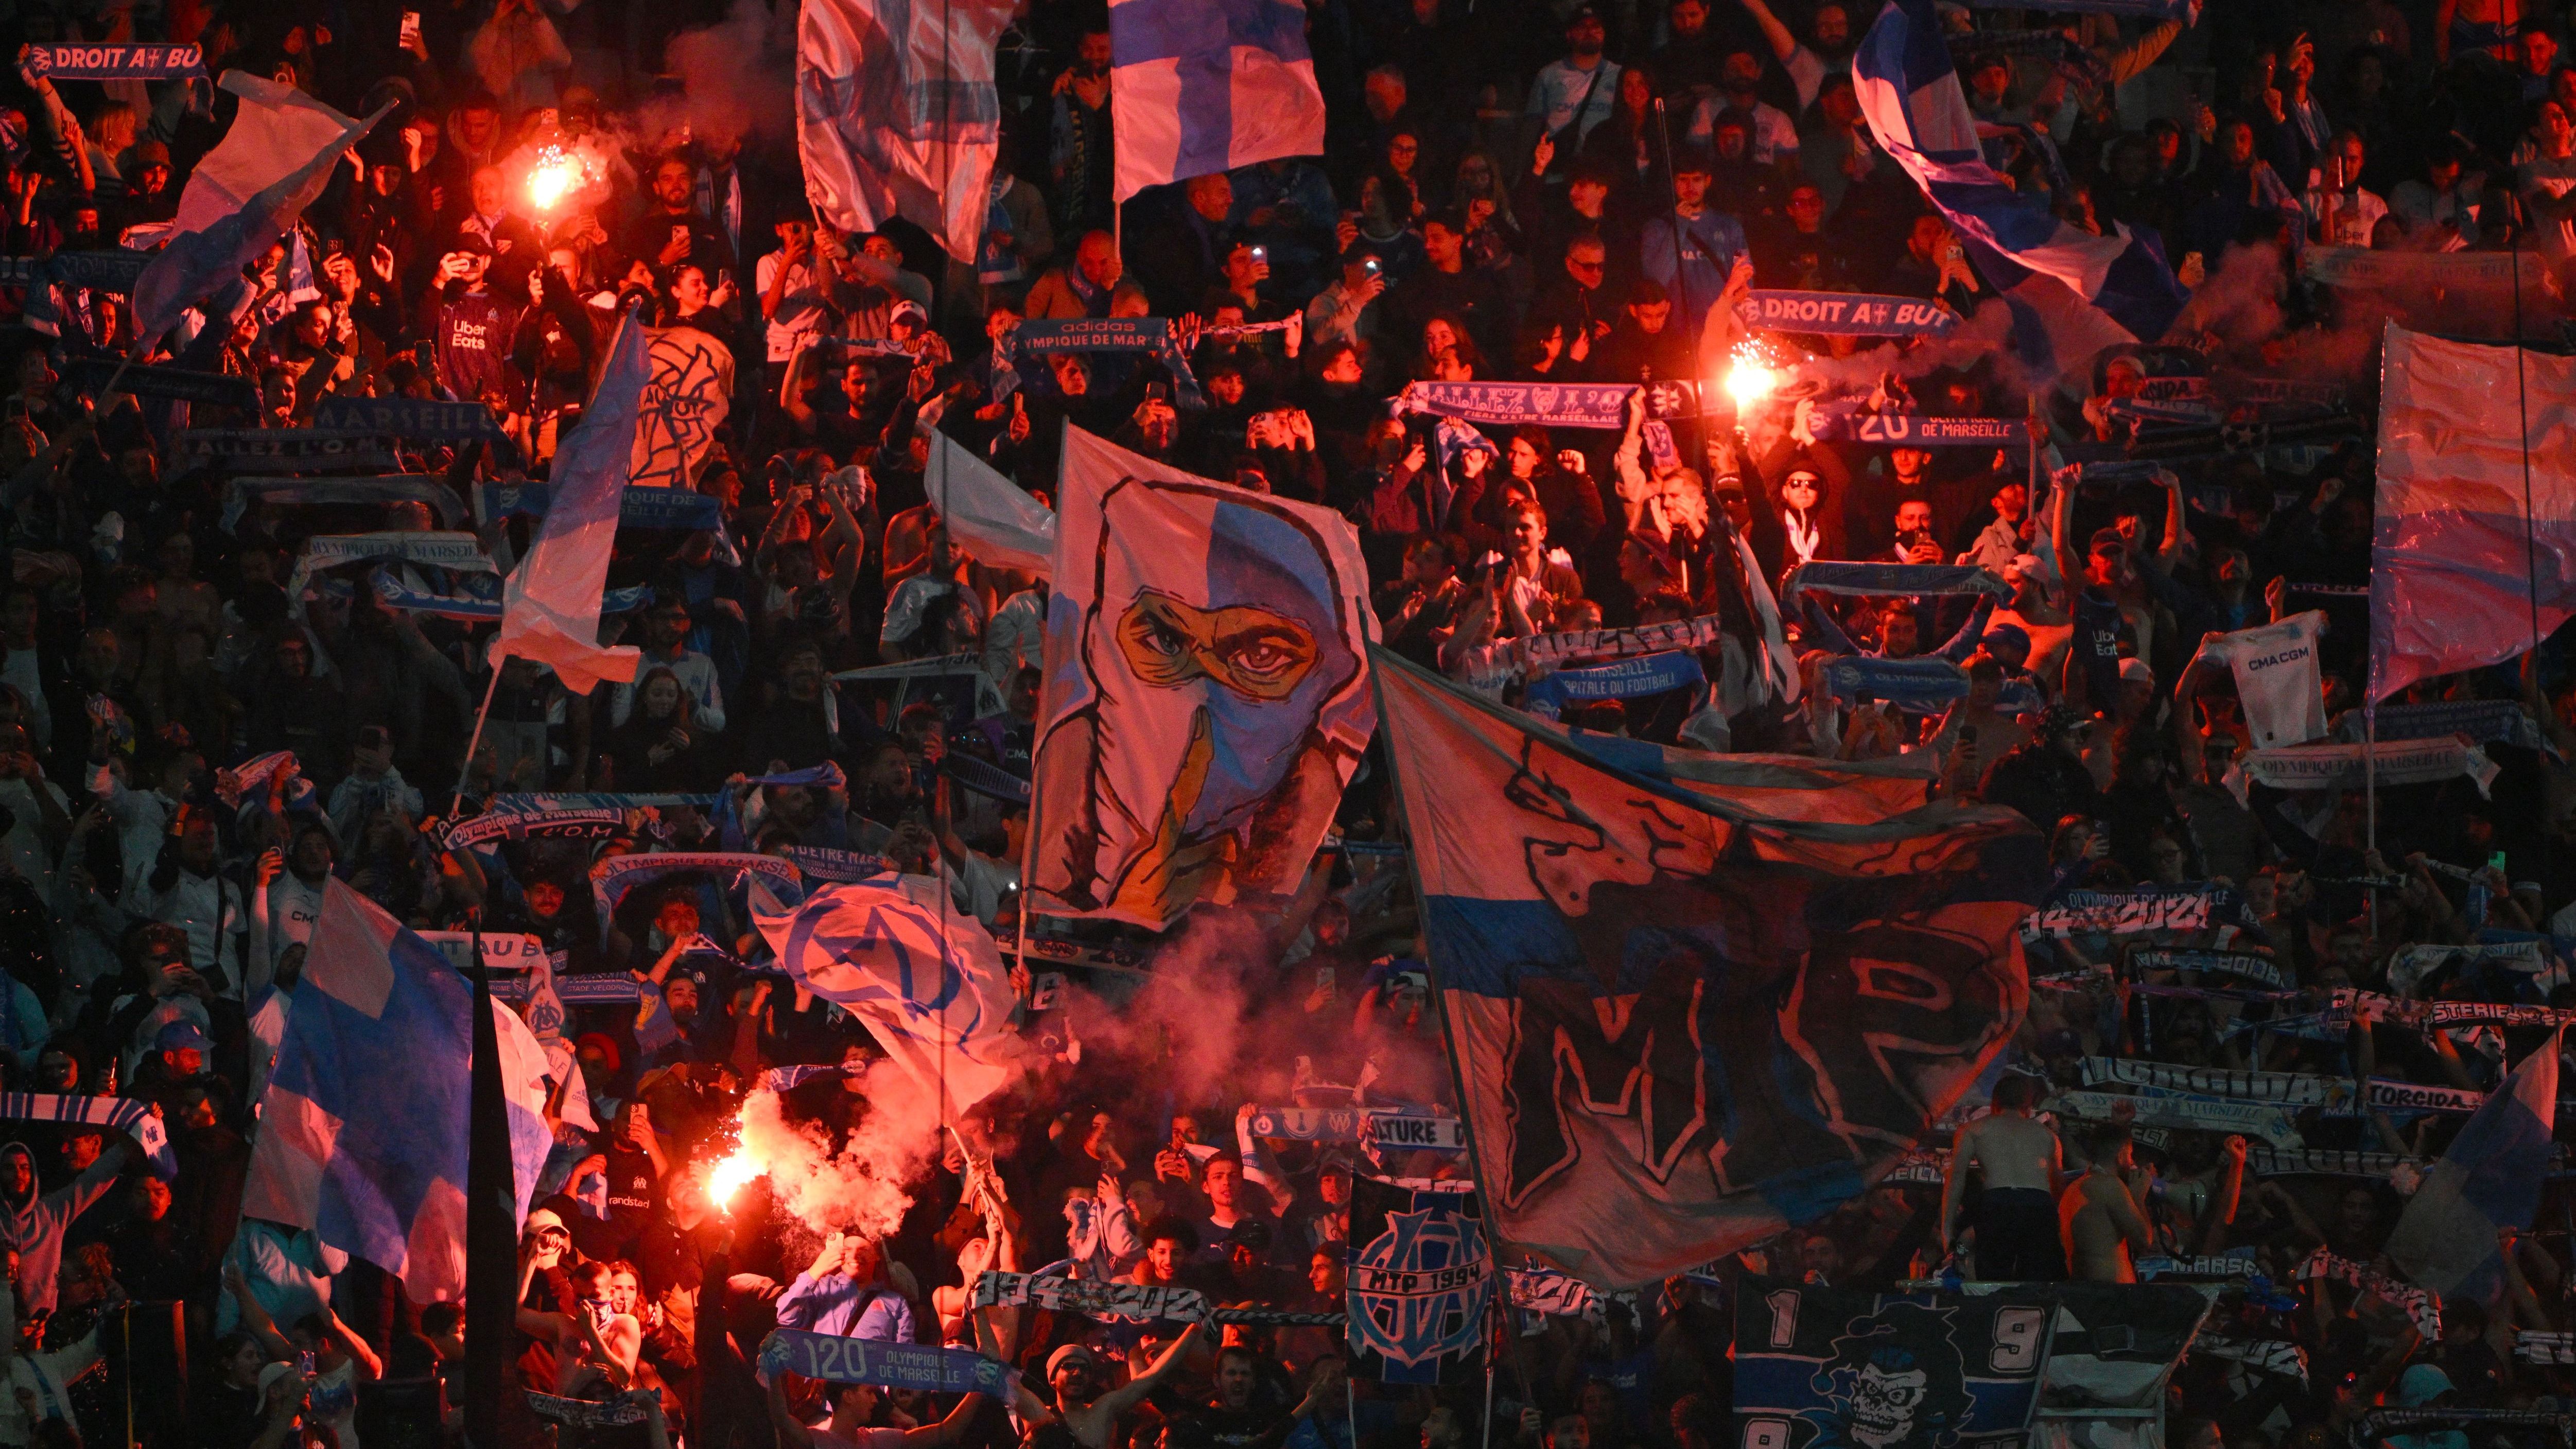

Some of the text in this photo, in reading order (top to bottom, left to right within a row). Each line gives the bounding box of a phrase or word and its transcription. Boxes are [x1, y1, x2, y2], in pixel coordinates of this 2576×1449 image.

[56, 48, 125, 68] DROIT
[165, 49, 201, 68] BU
[1765, 298, 1847, 322] DROIT
[1894, 304, 1950, 326] BUT
[454, 319, 486, 337] Uber
[1060, 321, 1136, 333] adidas
[452, 333, 486, 350] Eats
[1092, 335, 1109, 344] DE
[1431, 386, 1526, 413] ALLEZ
[1922, 424, 2011, 437] DE MARSEILLE
[671, 494, 696, 506] DE
[2249, 647, 2309, 671] CMA CGM
[1610, 678, 1625, 693] DU
[454, 812, 521, 844] Olympique
[2369, 1085, 2469, 1109] TORCIDA
[608, 1195, 650, 1209] randstad
[1369, 1263, 1481, 1294] MTP 1994
[1765, 1288, 2046, 1373] 1 9
[804, 1337, 868, 1379] 120
[886, 1350, 950, 1368] OLYMPIQUE
[878, 1365, 961, 1384] DE MARSEILLE
